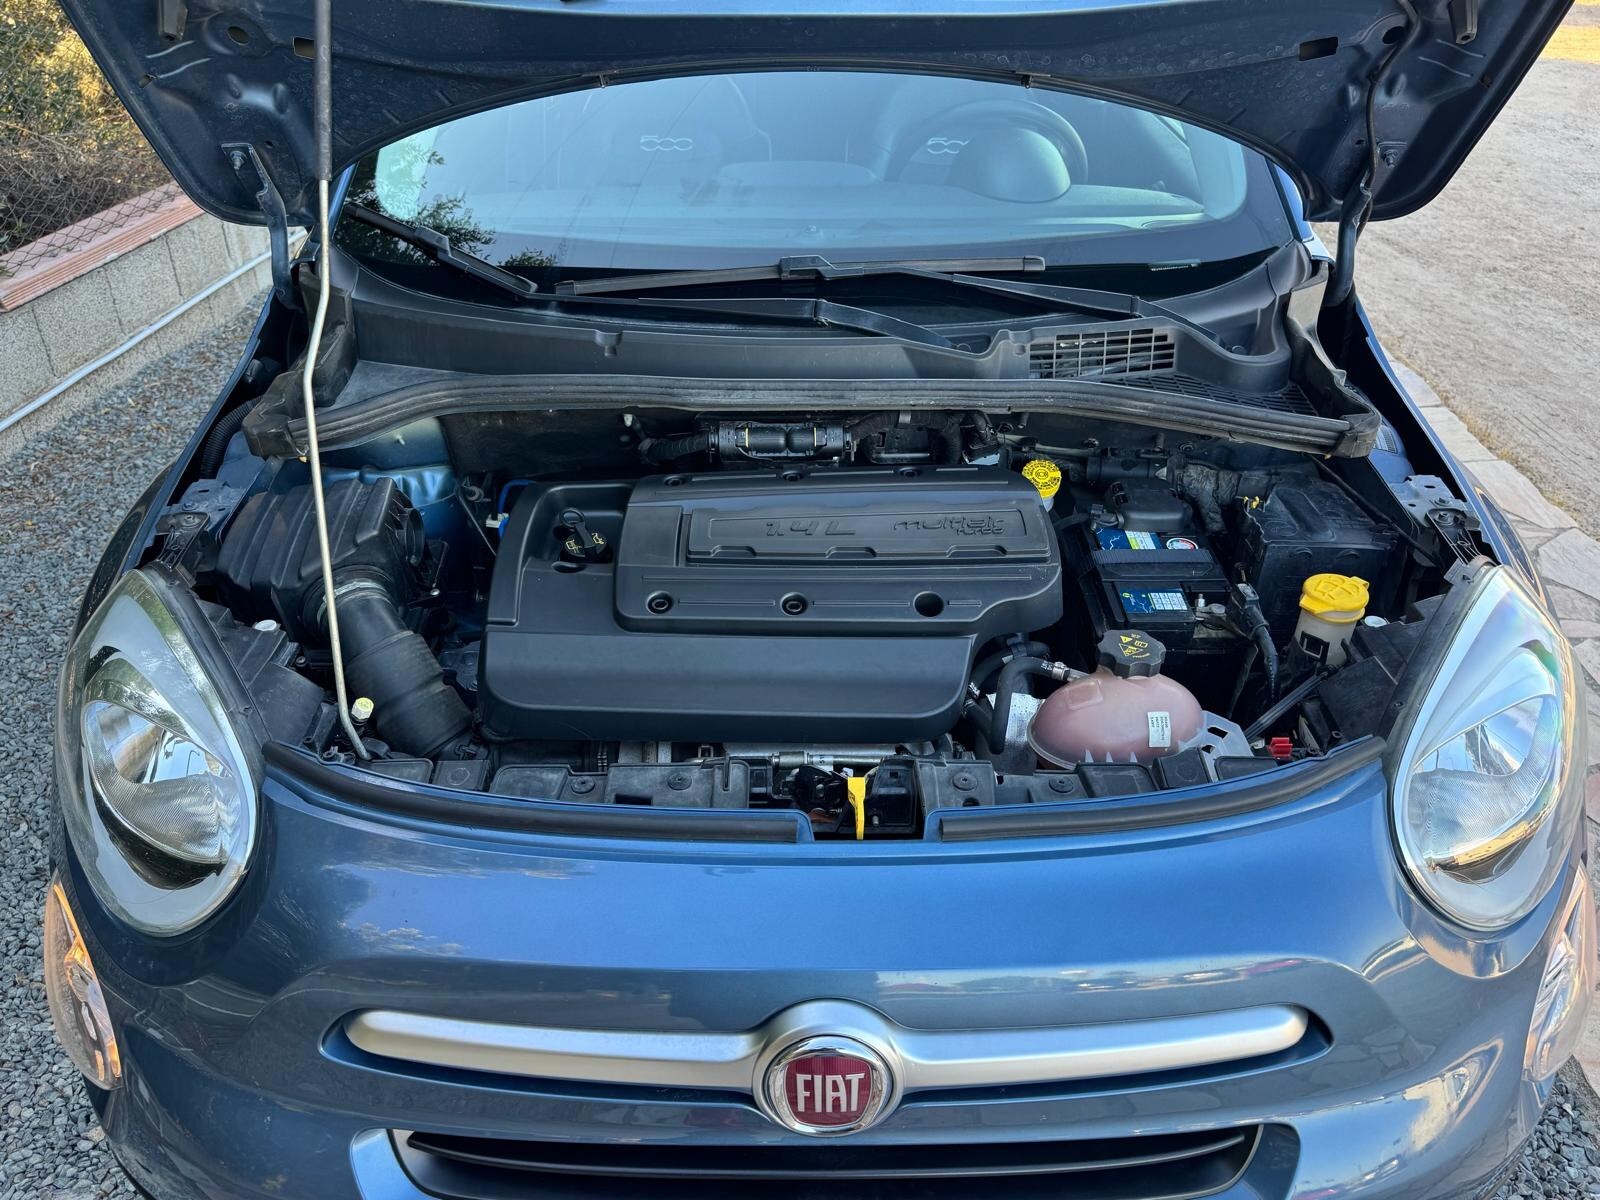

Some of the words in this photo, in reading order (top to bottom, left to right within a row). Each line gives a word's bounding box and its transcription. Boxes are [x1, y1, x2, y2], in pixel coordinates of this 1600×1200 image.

[639, 135, 693, 151] 500
[926, 137, 970, 154] 50
[796, 1072, 865, 1113] FIAT
